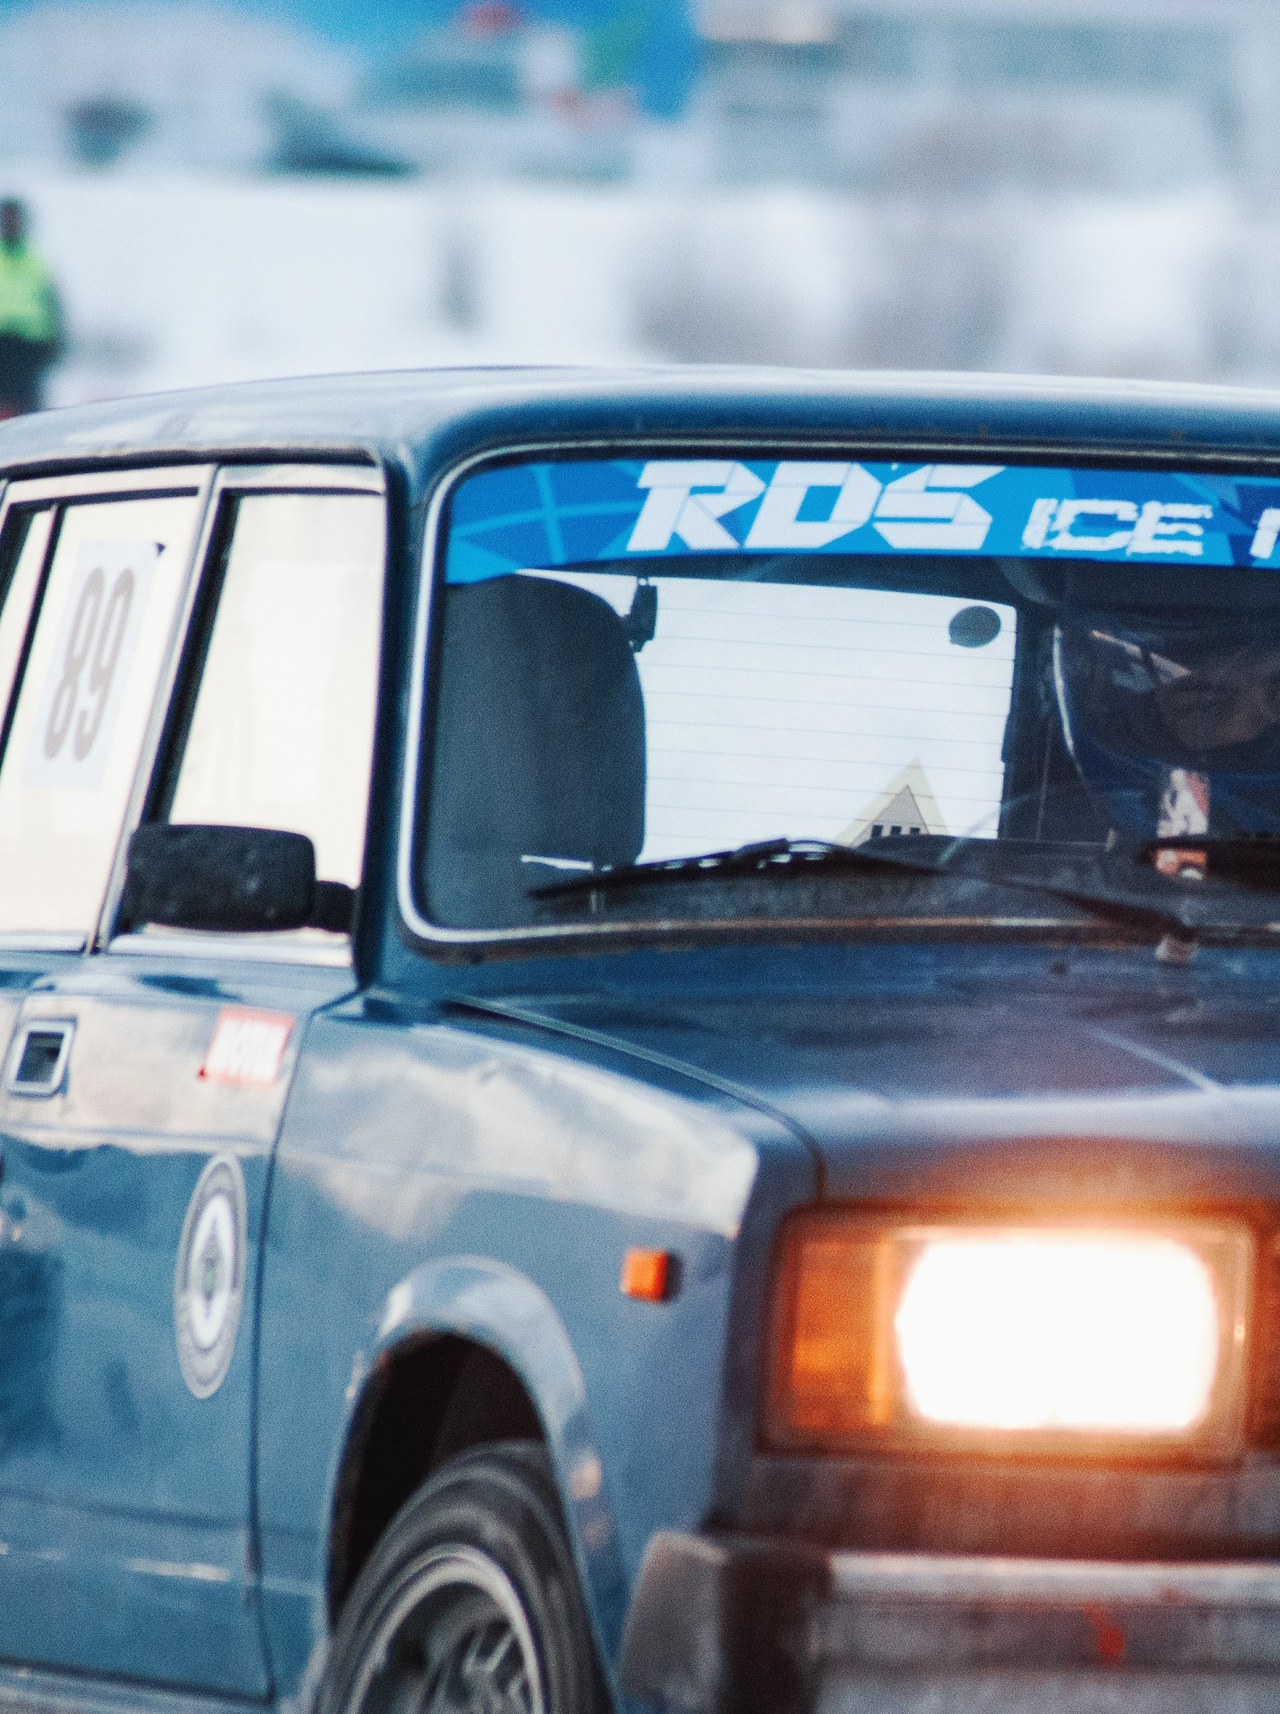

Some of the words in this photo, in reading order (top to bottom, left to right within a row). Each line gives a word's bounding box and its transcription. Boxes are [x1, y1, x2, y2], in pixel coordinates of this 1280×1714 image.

[626, 460, 1006, 551] RDS
[1022, 497, 1214, 556] ICE
[44, 566, 135, 762] 89
